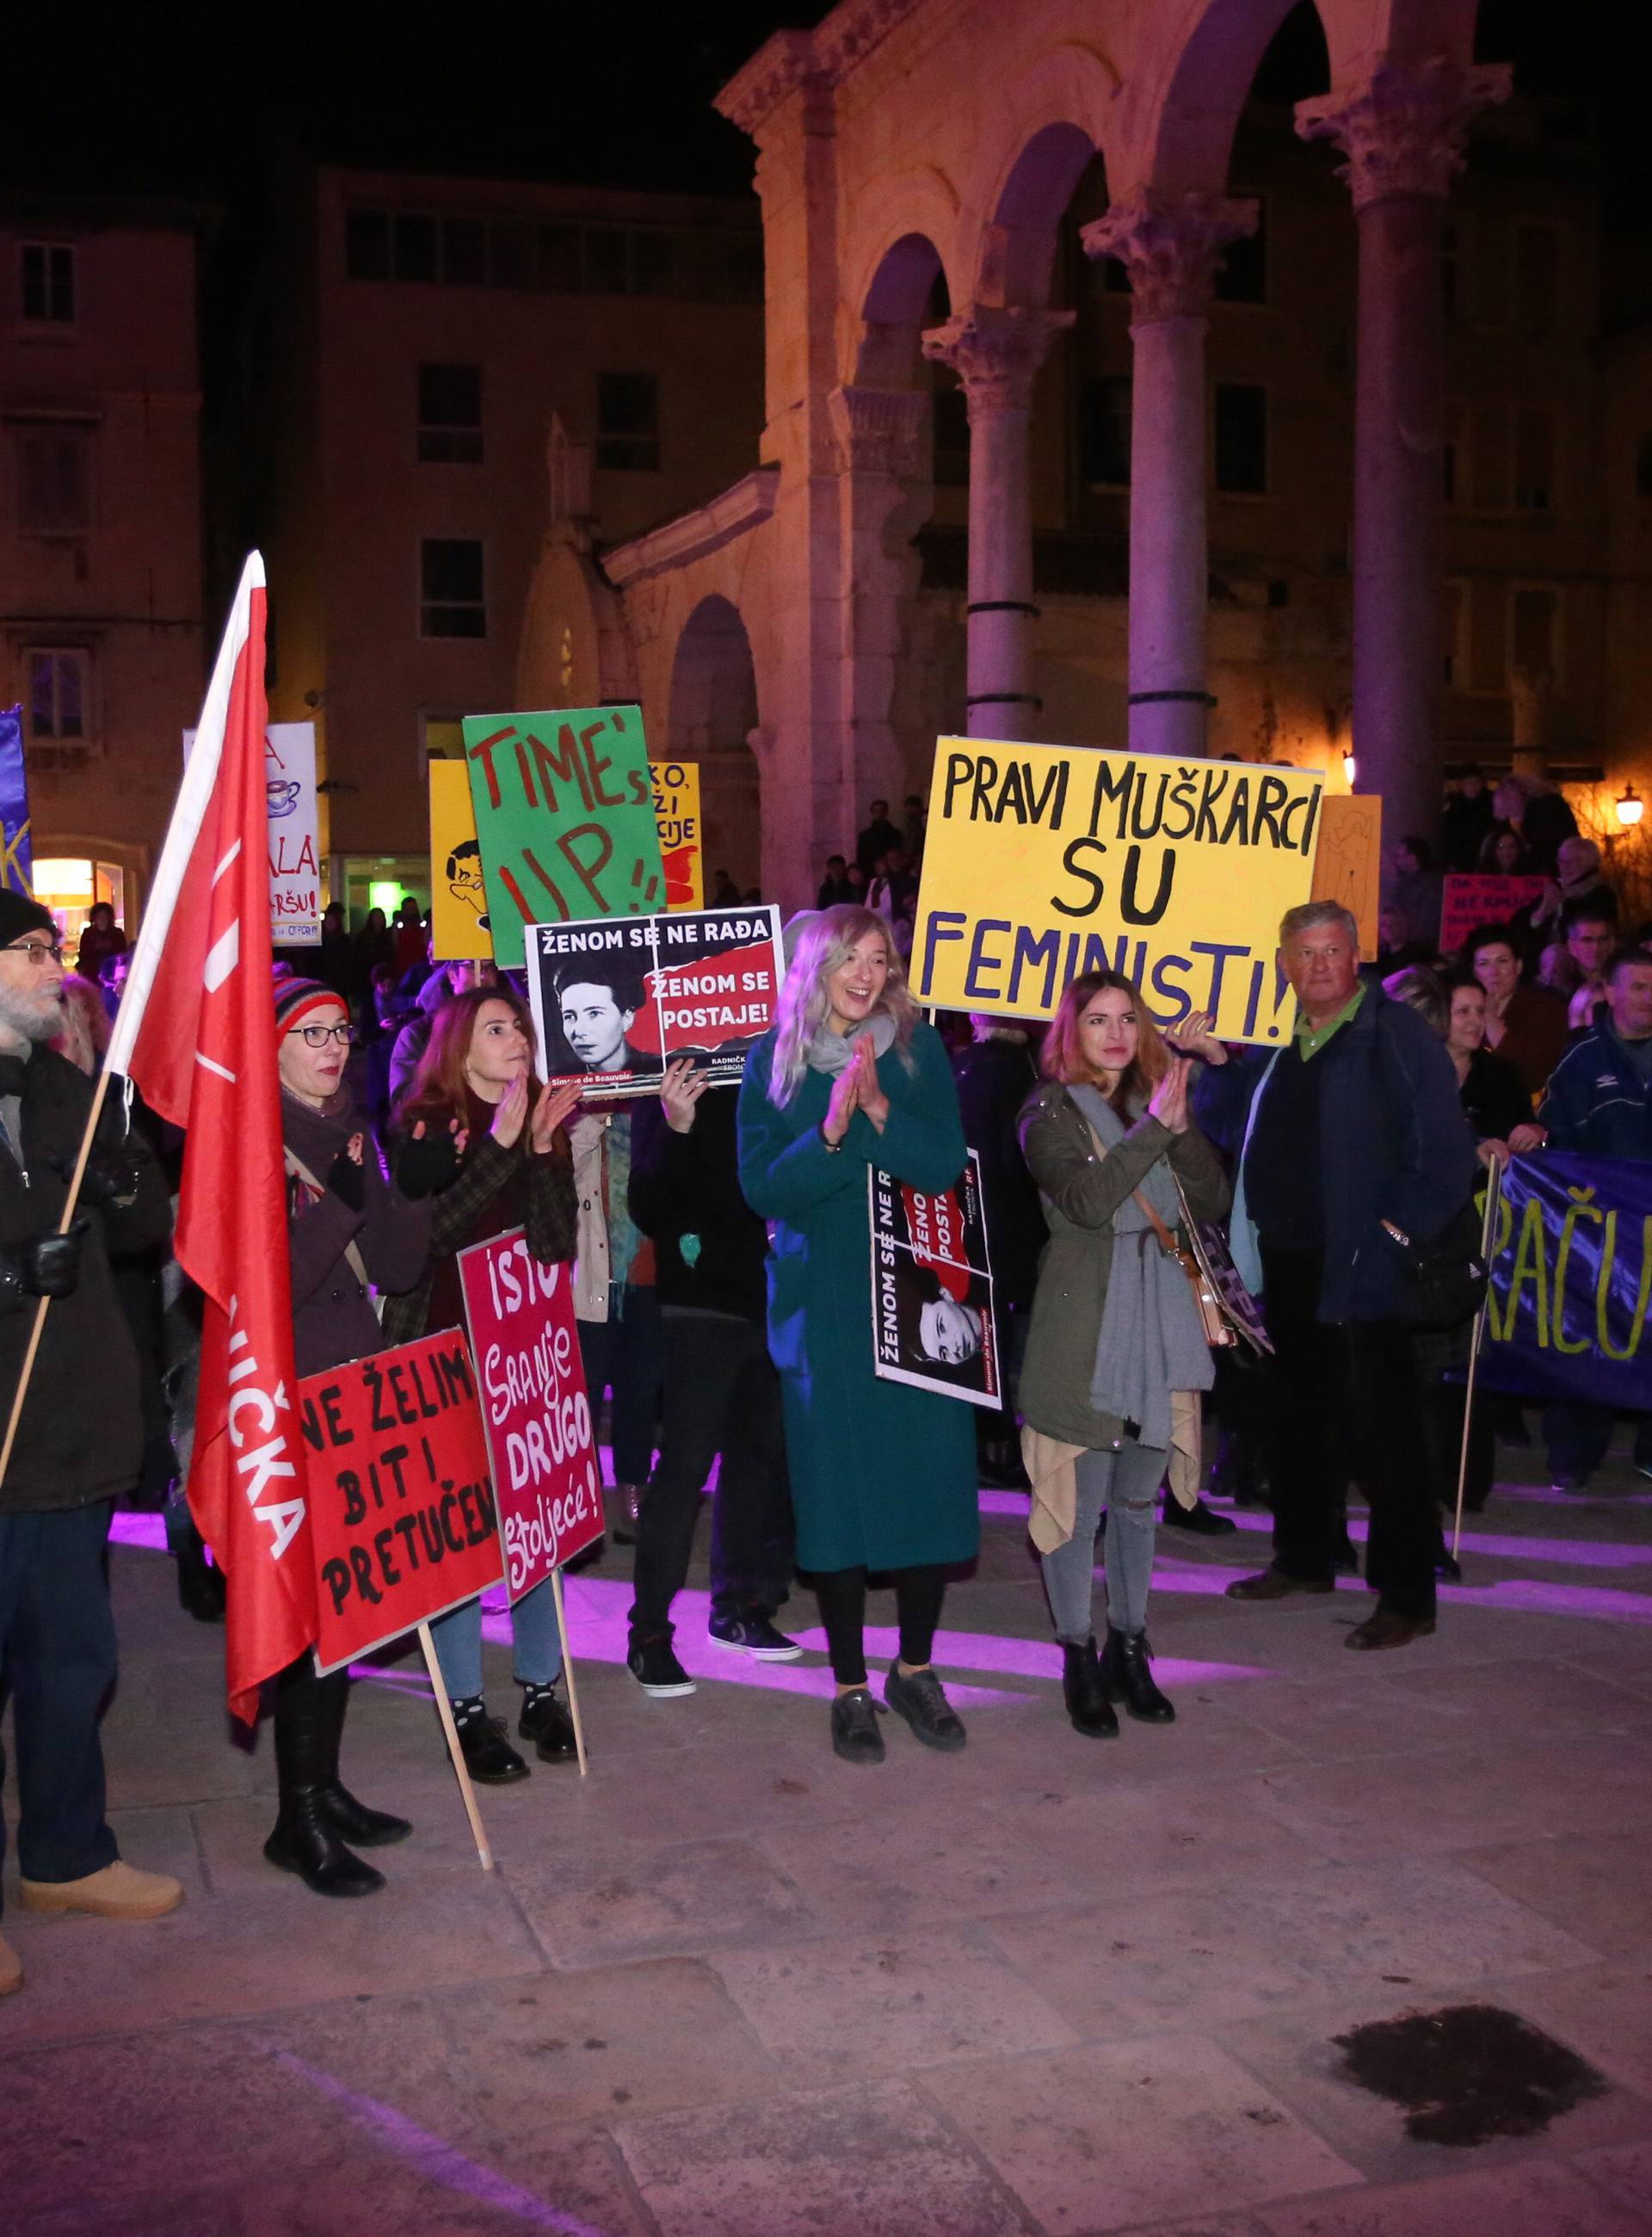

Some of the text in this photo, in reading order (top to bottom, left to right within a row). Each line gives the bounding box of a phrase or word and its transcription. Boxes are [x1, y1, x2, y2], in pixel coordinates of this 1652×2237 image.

[942, 752, 1322, 857] PRAVI MUŠKARCI
[1050, 836, 1176, 927] SU
[542, 919, 769, 954] ŽENOM SE NE RAĐA
[650, 971, 770, 998] ŽENOM SE
[663, 1003, 769, 1030] POSTAJE!
[878, 1169, 899, 1363] ŽENOM SE NE R
[301, 1347, 474, 1452] NE ŽELIM
[506, 1391, 591, 1491] DRUGO
